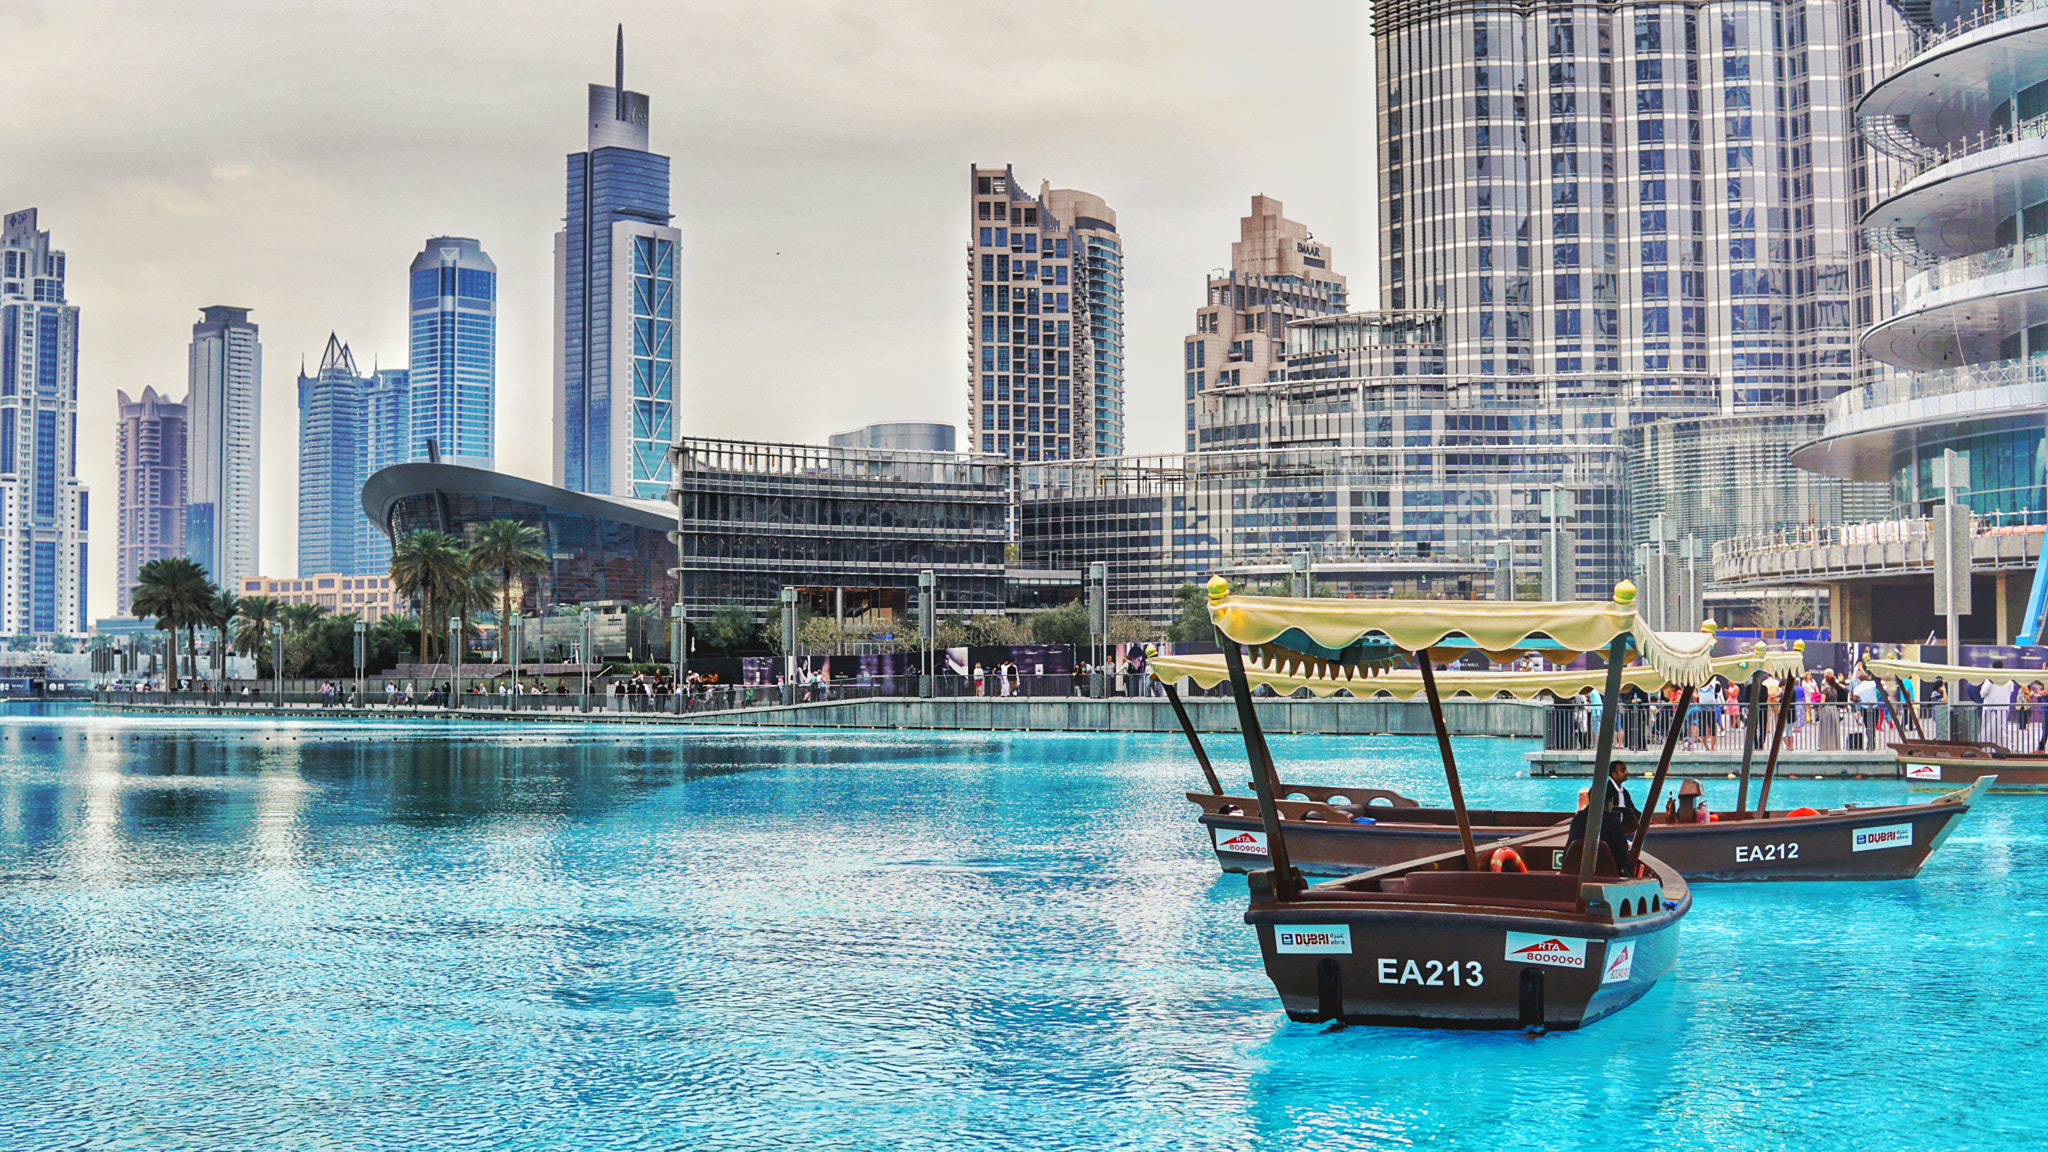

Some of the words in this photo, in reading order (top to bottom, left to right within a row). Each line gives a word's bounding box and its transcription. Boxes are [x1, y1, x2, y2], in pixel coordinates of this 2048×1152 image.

[1297, 242, 1320, 258] EMAAR
[1868, 831, 1896, 844] DUBAI
[1229, 844, 1267, 854] 8009090
[1735, 842, 1799, 862] EA212
[1295, 933, 1330, 946] DUBAI
[1538, 943, 1561, 951] RTA
[1527, 952, 1583, 966] 8009090
[1377, 958, 1484, 987] EA213
